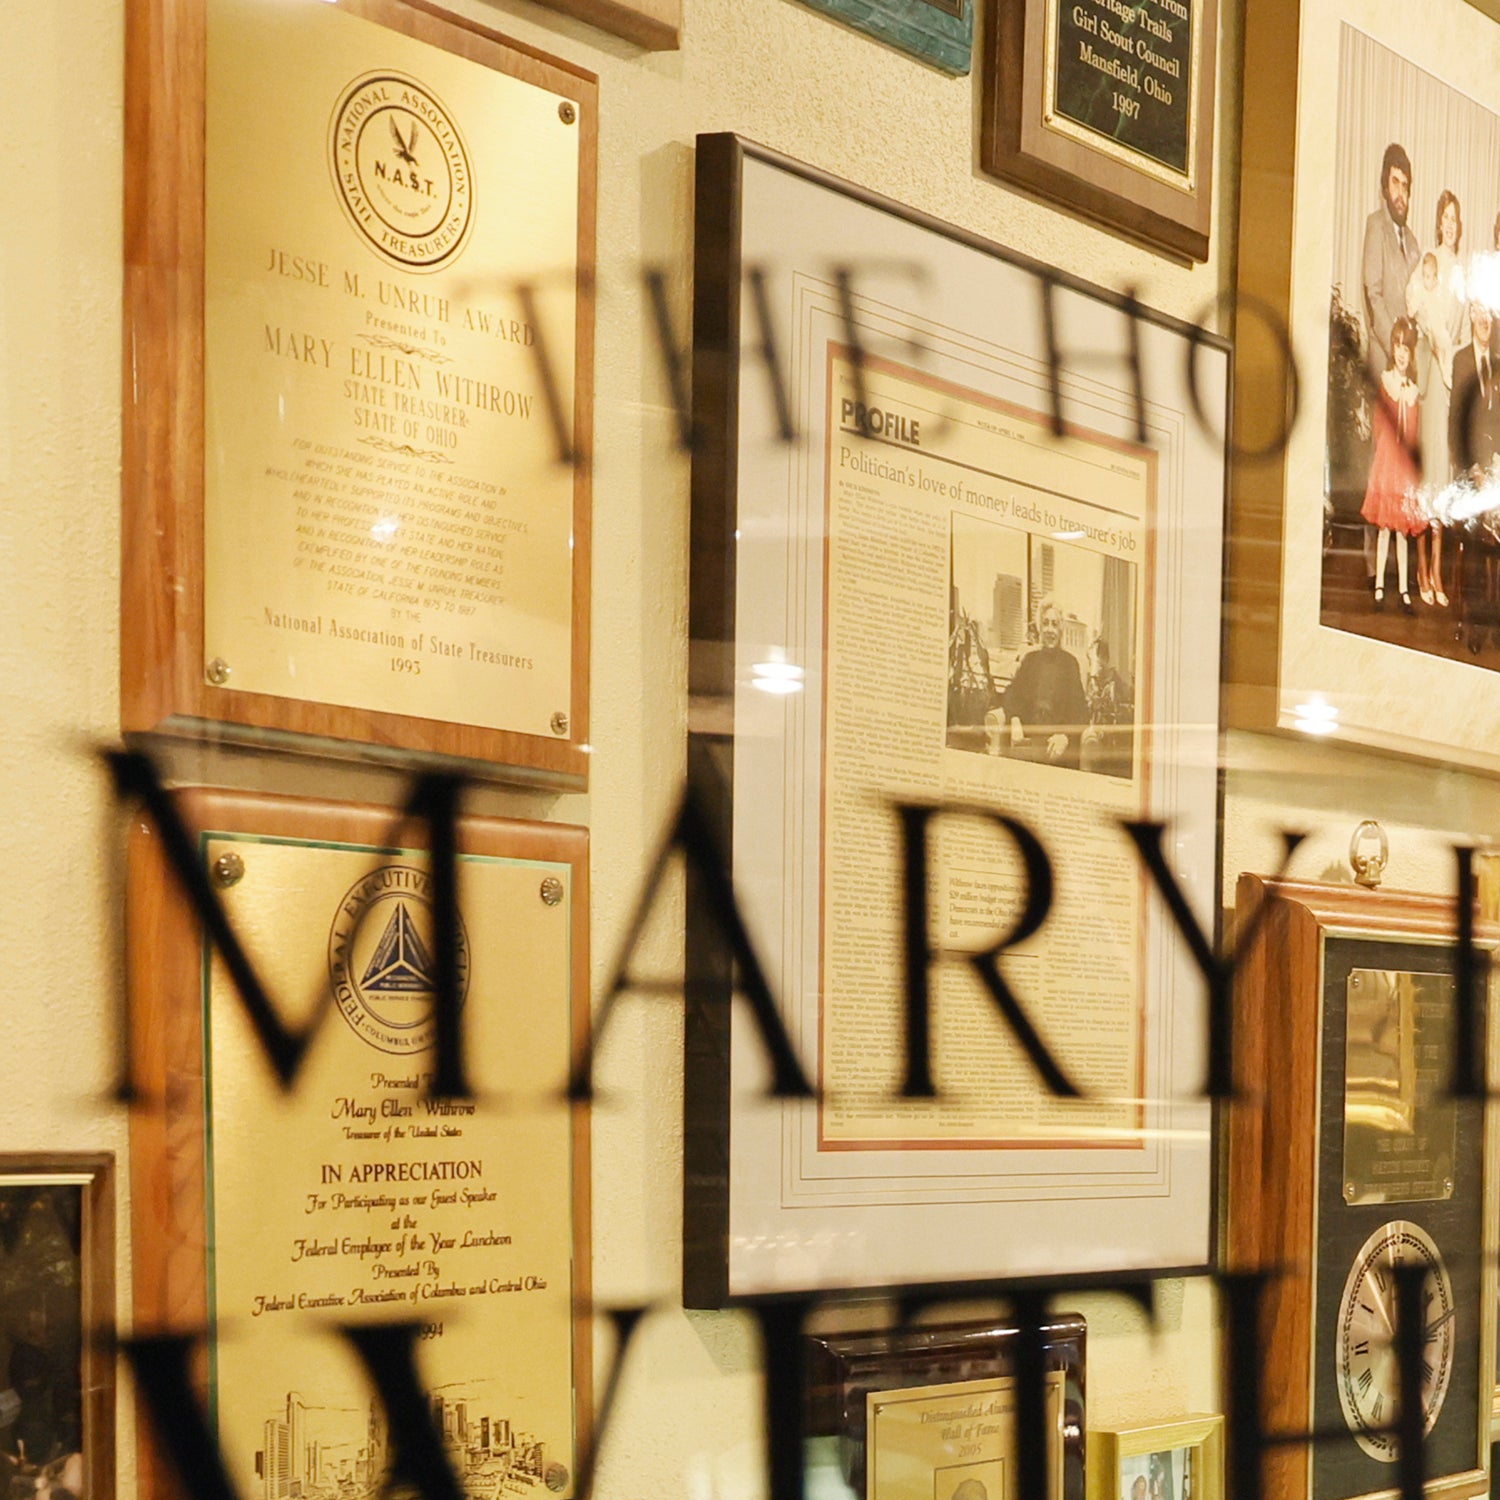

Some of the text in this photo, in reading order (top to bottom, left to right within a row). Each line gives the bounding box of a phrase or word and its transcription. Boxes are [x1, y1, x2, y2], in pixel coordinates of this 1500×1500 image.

[1072, 7, 1179, 78] Girl Scout Council
[1138, 8, 1173, 43] Trails
[1079, 41, 1172, 106] Mansfield, Ohio
[1112, 92, 1140, 120] 1997
[341, 88, 465, 195] NATIONAL ASSOCIATION
[345, 173, 461, 257] STATE TREASURERS
[265, 249, 535, 347] JESSE M. UNRUH AWARD
[366, 310, 446, 346] Presented To
[264, 324, 532, 420] MARY ELLEN WITHROW
[455, 258, 950, 468] THE
[344, 380, 386, 407] STATE
[354, 408, 457, 449] STATE OF OHIO
[841, 399, 920, 445] PROFILE
[840, 445, 1136, 551] Politician's love of money leads to treasurer's job
[264, 606, 534, 671] National Association of State Treasurers
[98, 740, 1318, 1105] MARY
[370, 1072, 419, 1089] Presented
[331, 1098, 476, 1124] Mary Ellen Withrow
[321, 1160, 482, 1184] IN APPRECIATION
[305, 1188, 497, 1214] For Participating as our Guest Speaker
[391, 1214, 417, 1230] at the
[291, 1230, 511, 1262] Federal Employee of the Year Luncheon
[372, 1261, 440, 1280] Presented By
[252, 1276, 547, 1316] Federal Executive Association of Columbus and Central Ohio
[420, 1322, 444, 1340] 994
